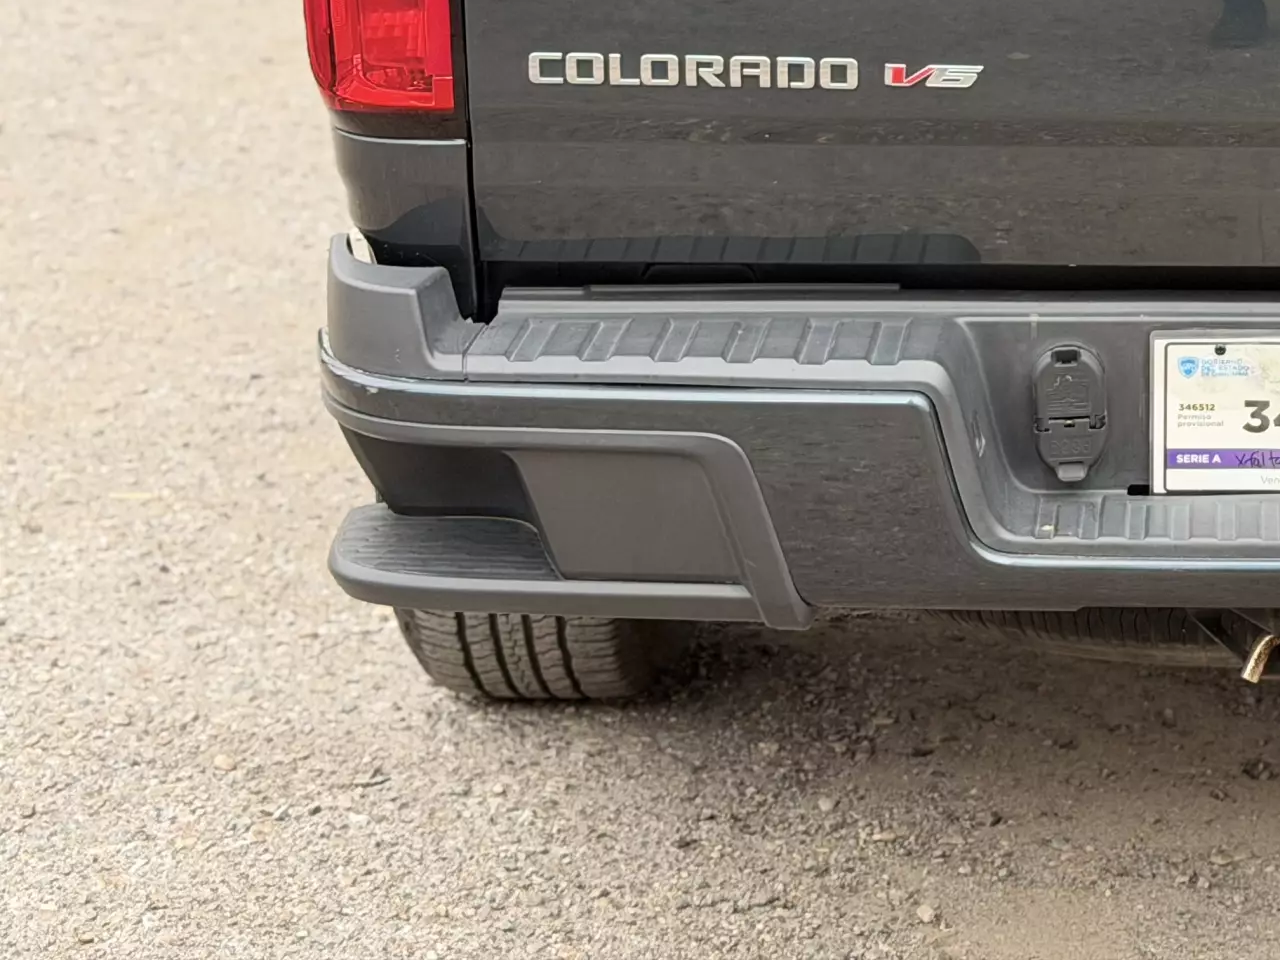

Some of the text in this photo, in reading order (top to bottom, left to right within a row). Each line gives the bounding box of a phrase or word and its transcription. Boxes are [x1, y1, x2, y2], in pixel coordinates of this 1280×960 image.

[528, 51, 984, 90] COLORADO V6
[1177, 420, 1224, 428] provisional
[1176, 454, 1222, 464] SERIE A
